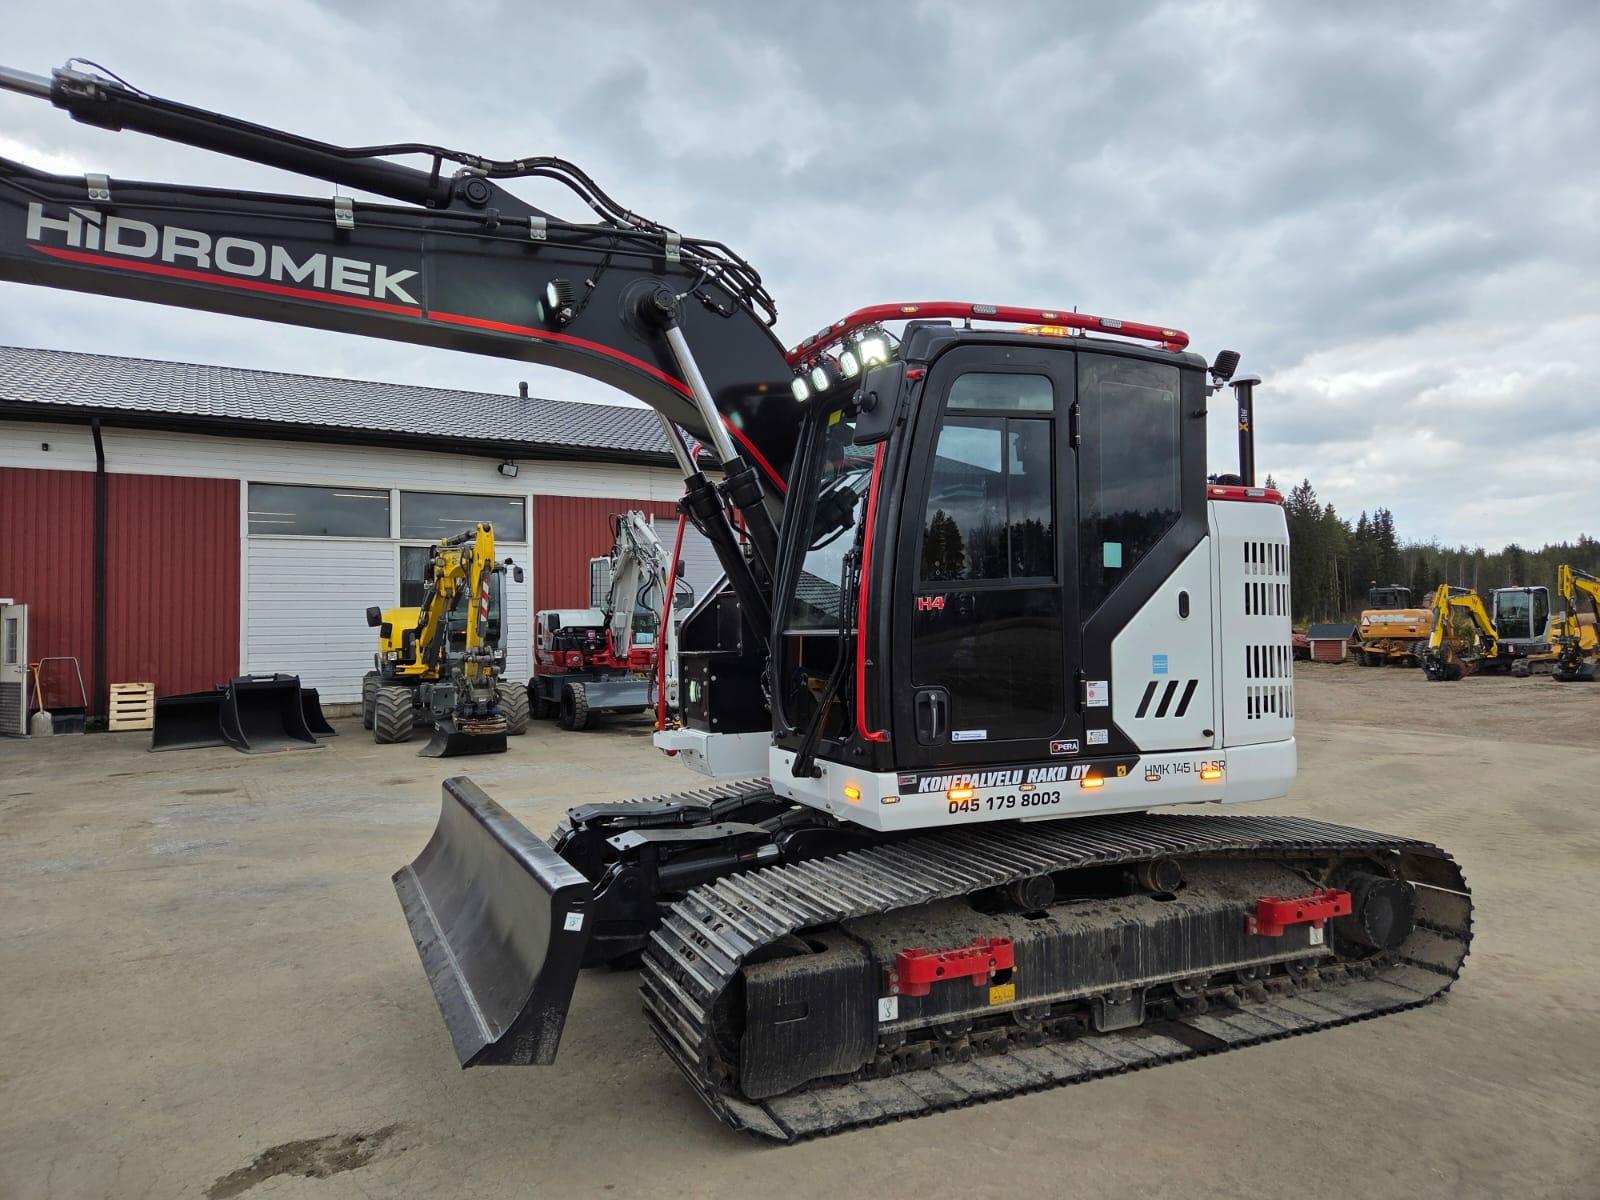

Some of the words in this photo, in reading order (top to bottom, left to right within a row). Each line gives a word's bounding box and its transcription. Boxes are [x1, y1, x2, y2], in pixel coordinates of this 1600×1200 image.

[917, 596, 945, 611] H4
[918, 768, 1025, 793] KONEPALVELU
[1028, 765, 1069, 783] RAKO
[1070, 764, 1092, 780] OY
[1144, 763, 1170, 776] HMK
[1172, 762, 1191, 774] 145
[948, 798, 980, 814] 045
[985, 796, 1016, 811] 179
[1020, 790, 1061, 807] 8003
